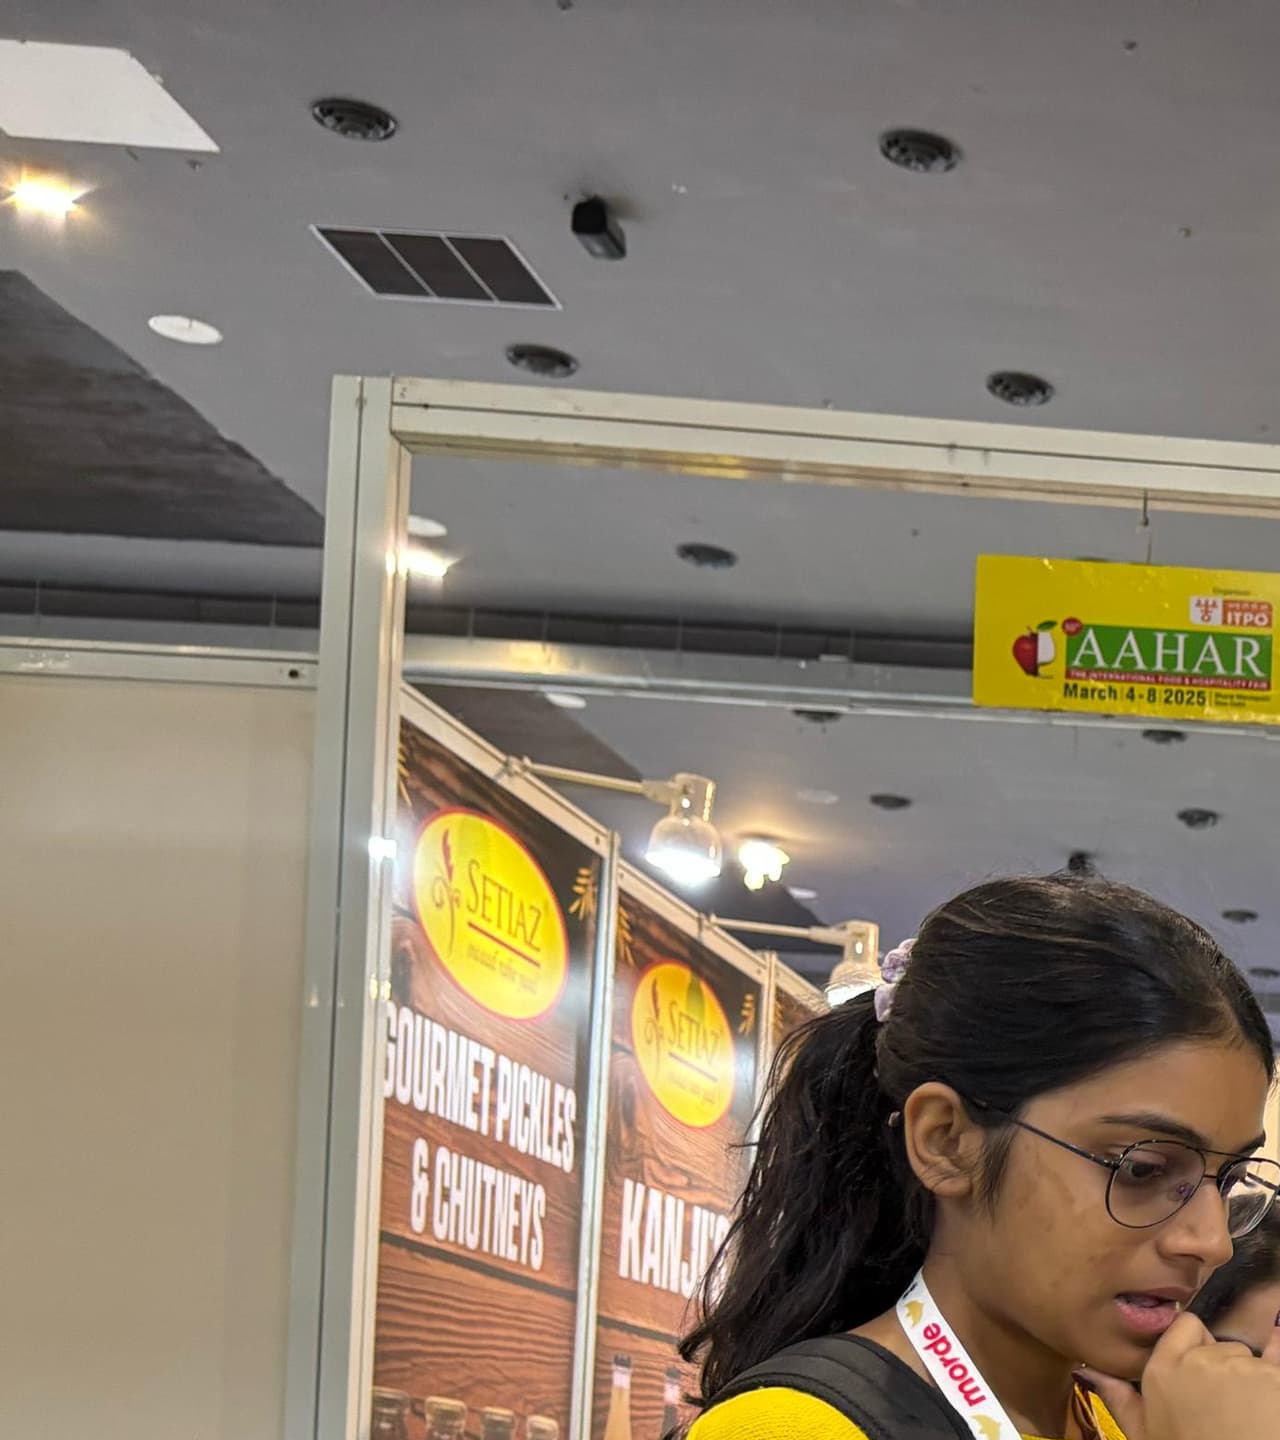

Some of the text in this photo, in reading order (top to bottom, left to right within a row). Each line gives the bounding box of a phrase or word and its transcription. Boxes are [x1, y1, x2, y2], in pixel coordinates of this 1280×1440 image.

[1227, 609, 1269, 626] ITPO
[1072, 628, 1266, 677] AAHAR
[1087, 671, 1157, 683] INTERNATIONAL
[1159, 675, 1183, 685] FOOD
[1063, 682, 1118, 700] March
[1163, 689, 1207, 706] 2025
[466, 857, 542, 953] SETIAZ
[382, 1000, 577, 1173] GOURMET PICKLES
[411, 1137, 547, 1272] & CHUTNEYS
[922, 1321, 987, 1407] morde
